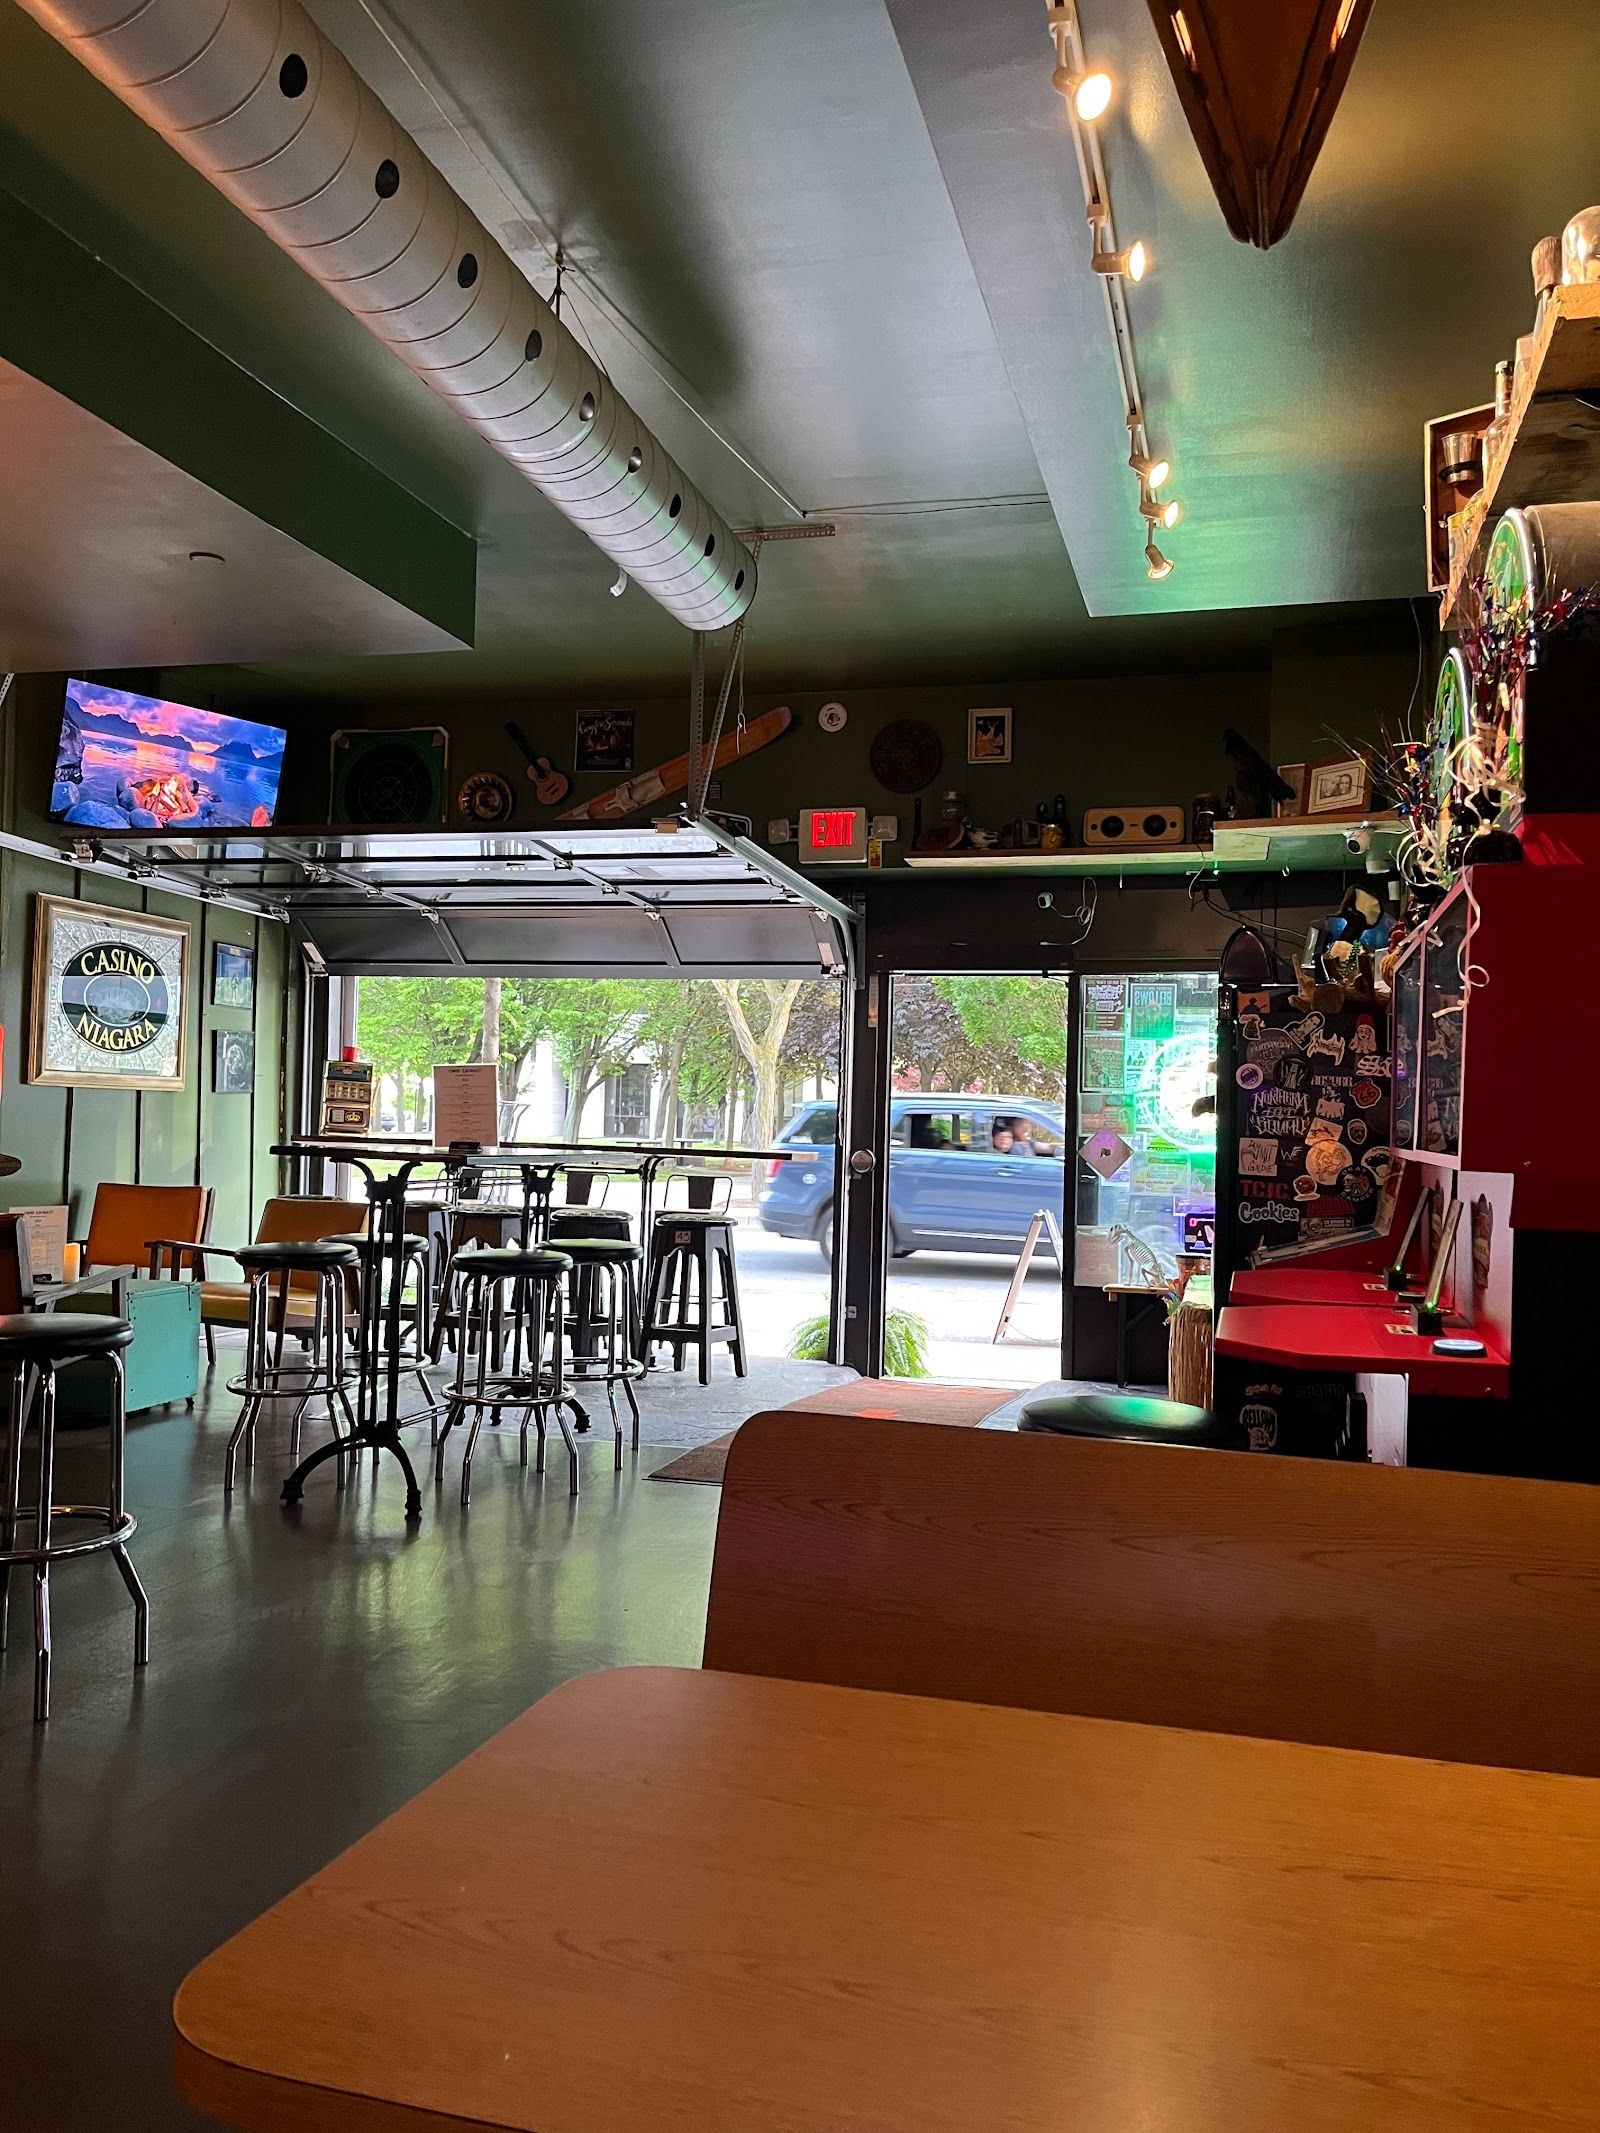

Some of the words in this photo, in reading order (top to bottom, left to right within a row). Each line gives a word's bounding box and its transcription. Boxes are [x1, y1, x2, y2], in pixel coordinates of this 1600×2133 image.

[812, 811, 856, 848] EXIT
[81, 948, 155, 985] CASINO
[76, 1013, 159, 1052] NIAGARA
[1238, 1201, 1300, 1224] Cookies
